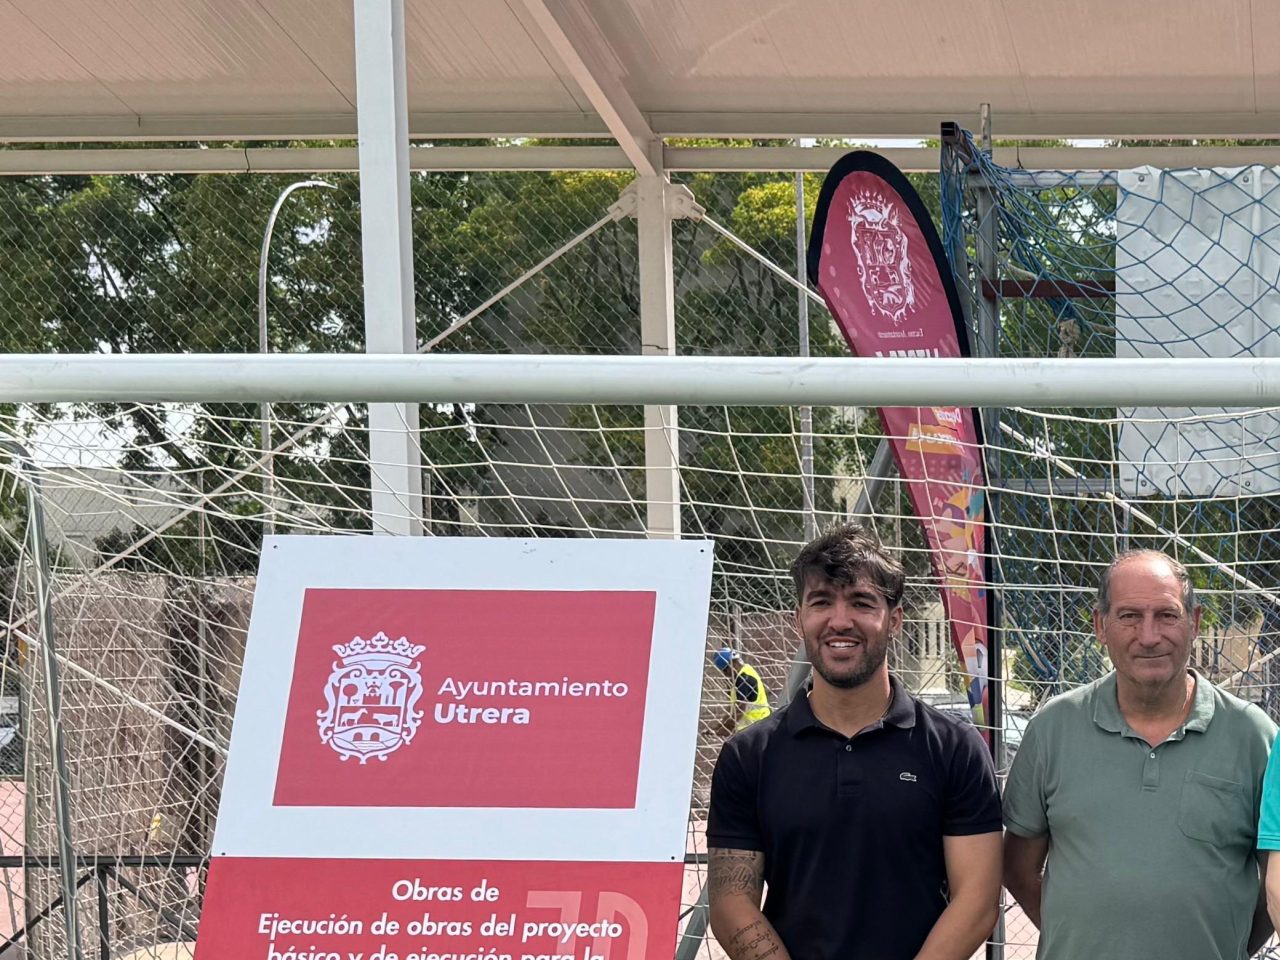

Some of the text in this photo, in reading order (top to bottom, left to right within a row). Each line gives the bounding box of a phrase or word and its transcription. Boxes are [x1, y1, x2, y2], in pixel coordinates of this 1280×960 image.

[436, 676, 629, 702] Ayuntamiento
[434, 703, 530, 725] Utrera
[392, 878, 500, 902] Obras de
[258, 912, 623, 944] Ejecución de obras del proyecto
